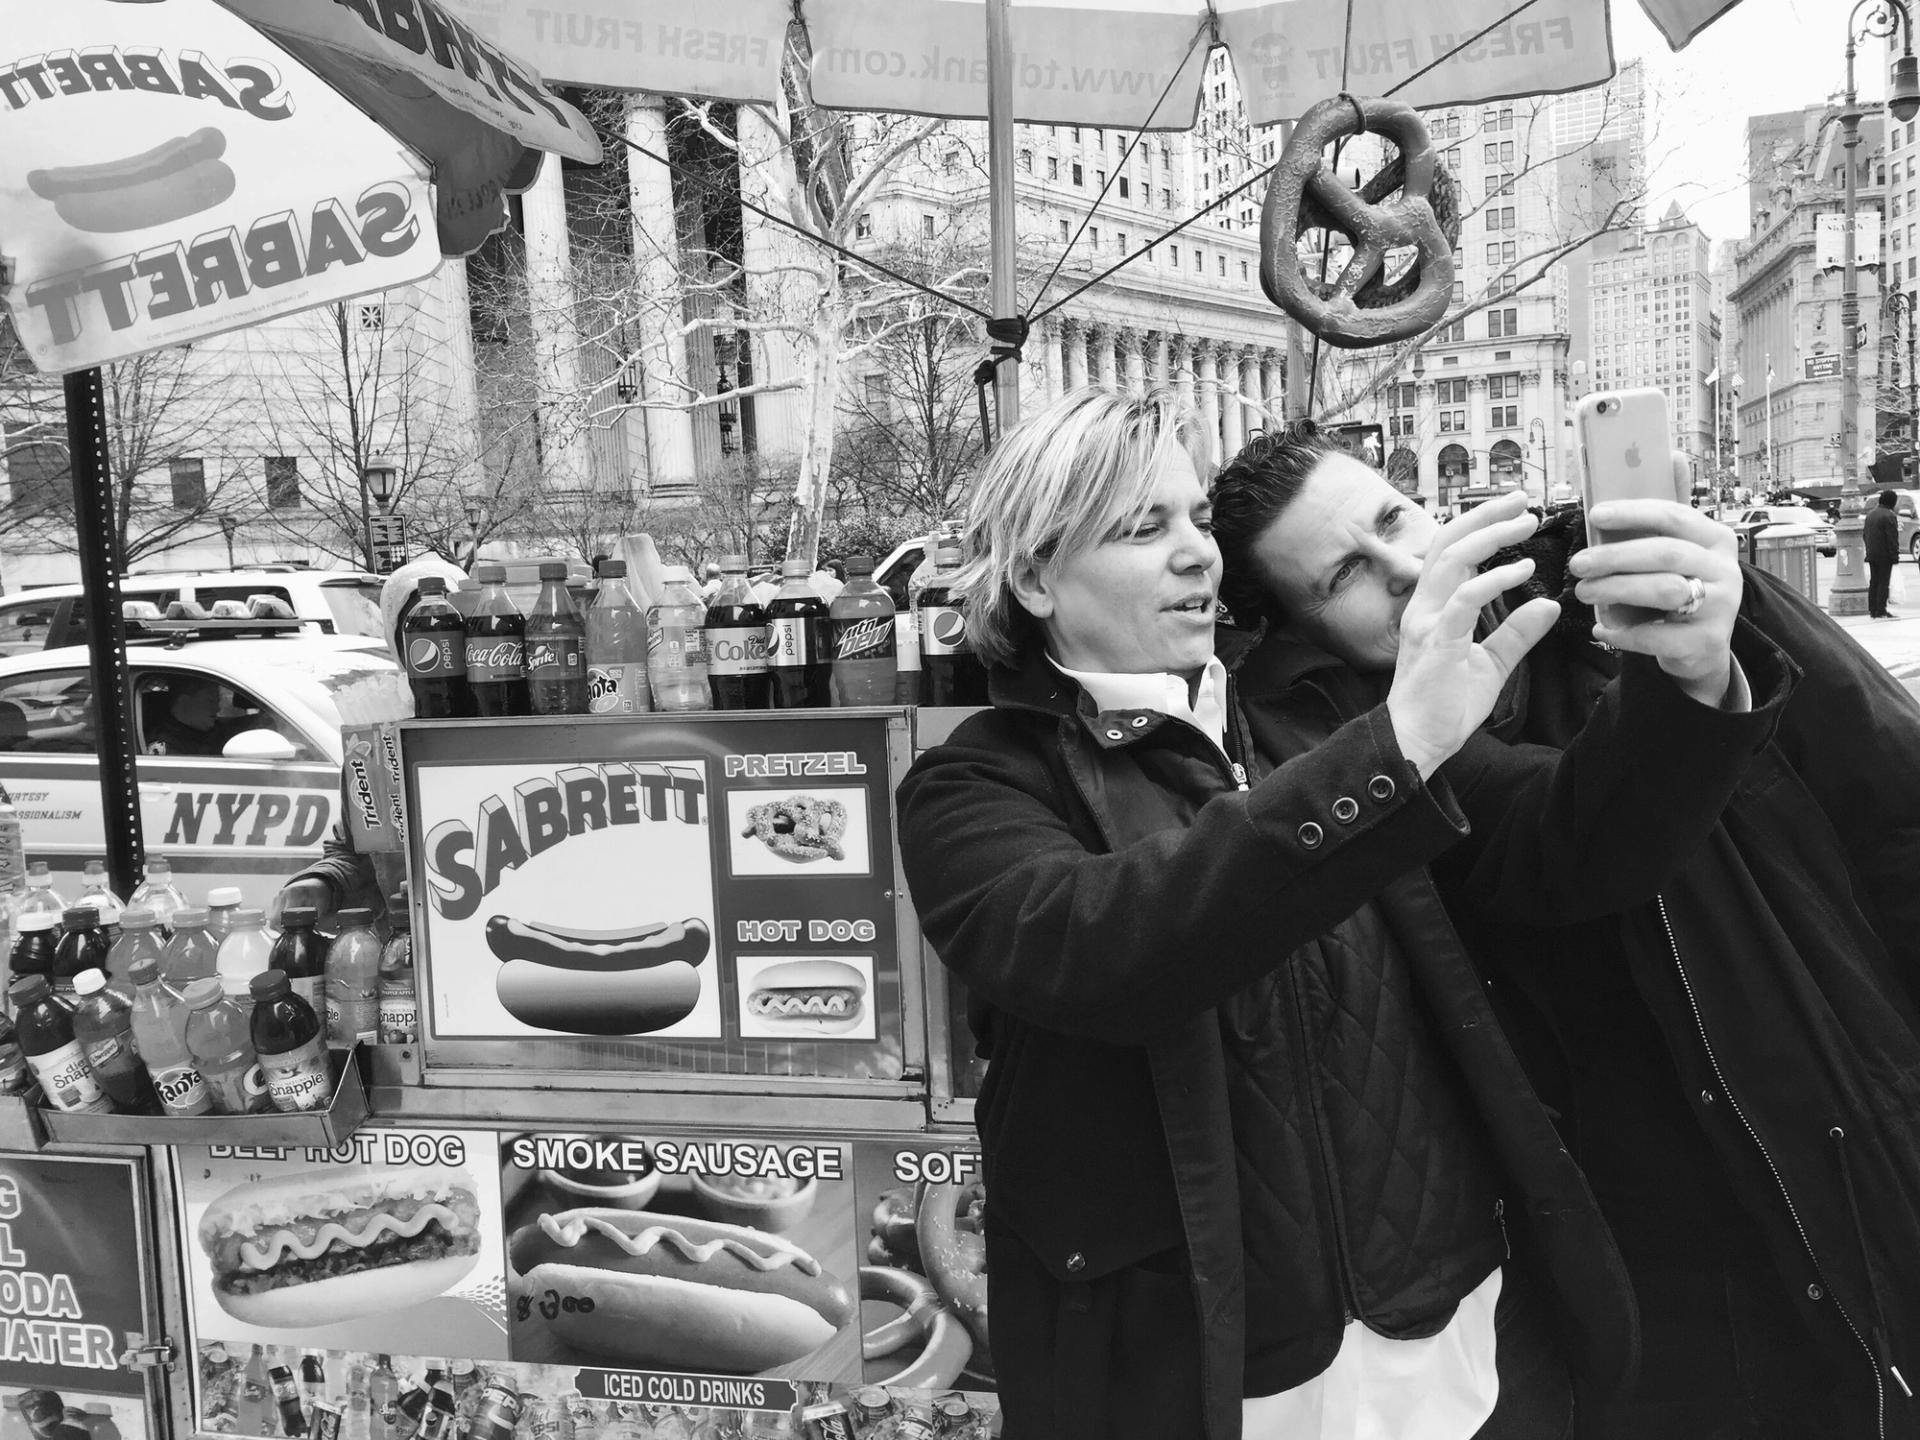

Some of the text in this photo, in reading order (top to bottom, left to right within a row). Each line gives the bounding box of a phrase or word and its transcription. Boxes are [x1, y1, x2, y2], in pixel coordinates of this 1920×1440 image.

[440, 639, 454, 669] pepsi
[715, 640, 767, 661] Coke
[783, 624, 795, 656] pepsi
[465, 641, 524, 668] Coca-Cola
[528, 650, 555, 671] Sprite
[588, 676, 617, 703] anta
[383, 735, 400, 784] Trident
[725, 752, 867, 777] PRETZEL
[8, 792, 49, 802] URTESY
[351, 759, 382, 830] Trident
[163, 792, 331, 846] NYPD
[424, 762, 705, 921] SABRETT
[737, 920, 876, 942] HOT DOG
[379, 1009, 416, 1028] nappl
[53, 1064, 92, 1089] Snap
[66, 1057, 86, 1074] die
[270, 1072, 324, 1096] Snapple
[384, 1133, 466, 1167] DOG
[512, 1137, 844, 1181] SMOKE SAUSAGE
[894, 1150, 982, 1186] SOF
[0, 1270, 82, 1319] ODA
[604, 1373, 766, 1407] ICED COLD DRINKS
